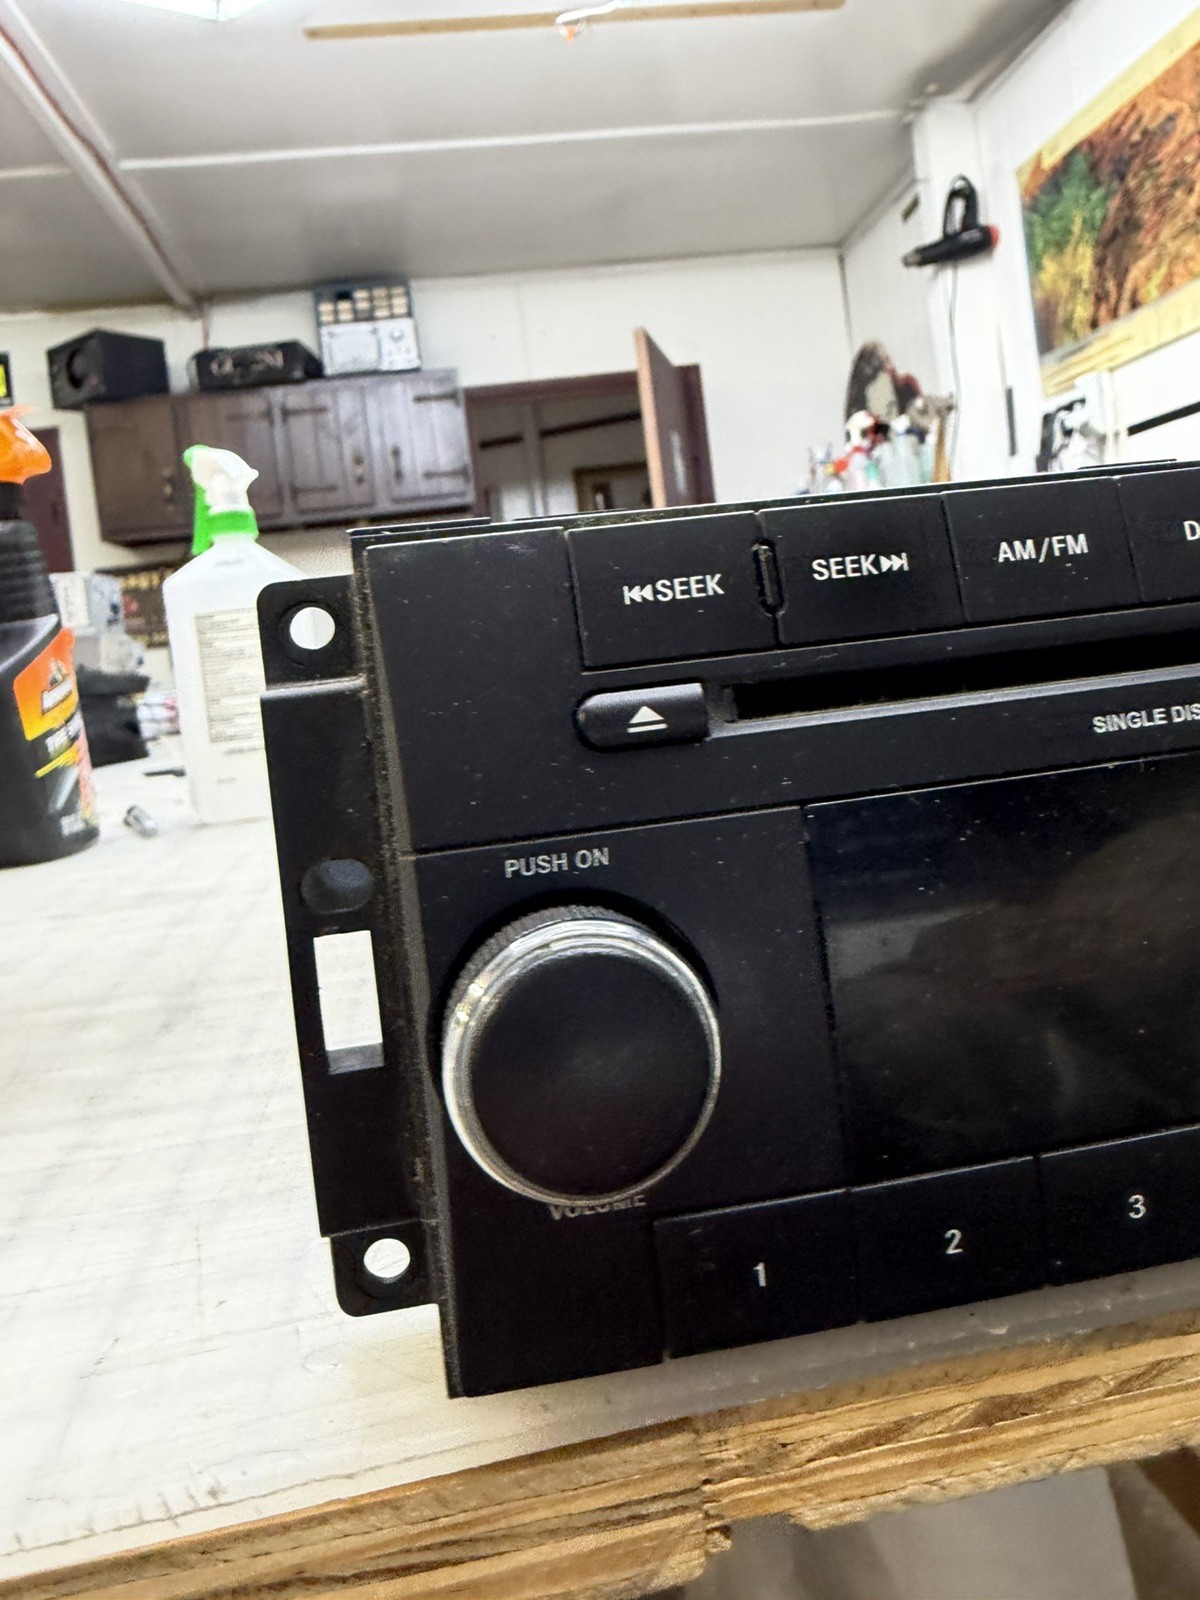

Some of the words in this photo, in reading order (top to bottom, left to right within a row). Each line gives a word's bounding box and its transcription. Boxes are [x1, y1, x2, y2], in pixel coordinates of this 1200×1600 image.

[997, 533, 1089, 564] AM/FM
[811, 553, 879, 581] SEEK
[655, 573, 725, 602] SEEK
[1092, 707, 1169, 734] SINGLE
[503, 852, 569, 878] PUSH
[574, 847, 610, 869] ON
[1128, 1194, 1147, 1219] 3
[945, 1229, 963, 1255] 2
[753, 1262, 767, 1287] 1
